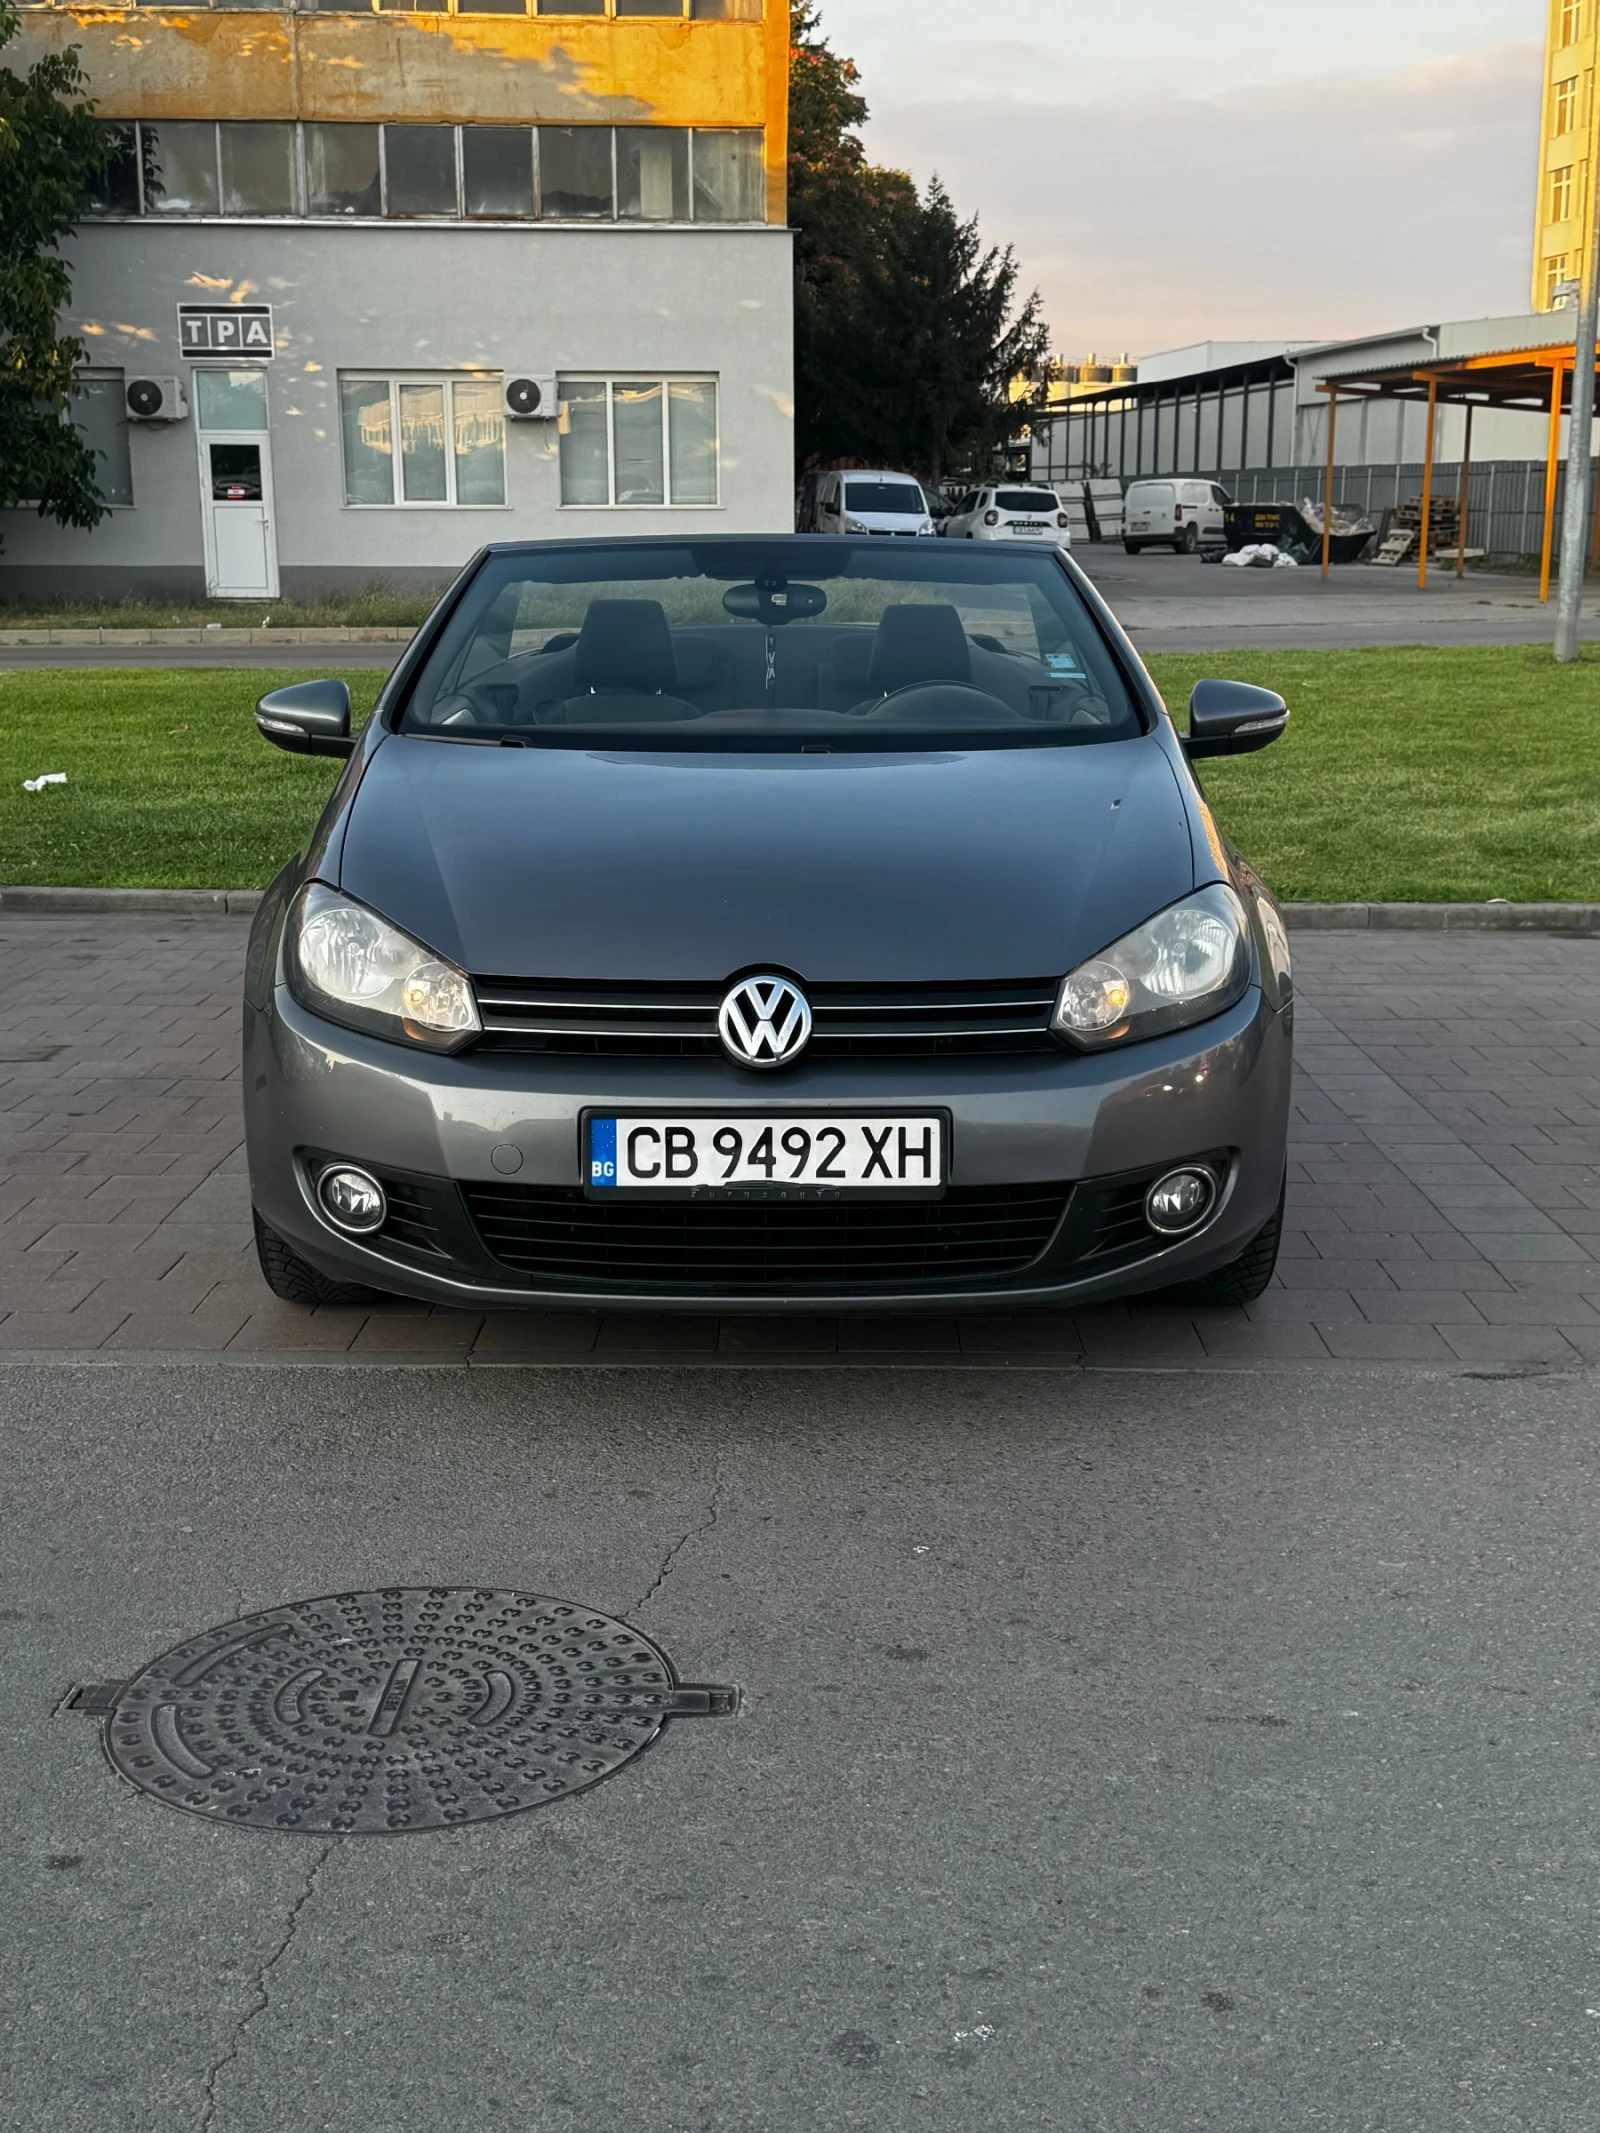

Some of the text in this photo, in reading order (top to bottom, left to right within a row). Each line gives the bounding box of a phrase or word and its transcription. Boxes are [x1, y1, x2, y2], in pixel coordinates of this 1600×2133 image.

[186, 320, 268, 343] TPA
[719, 975, 811, 1067] VW
[592, 1126, 931, 1178] BG CB 9492 XH
